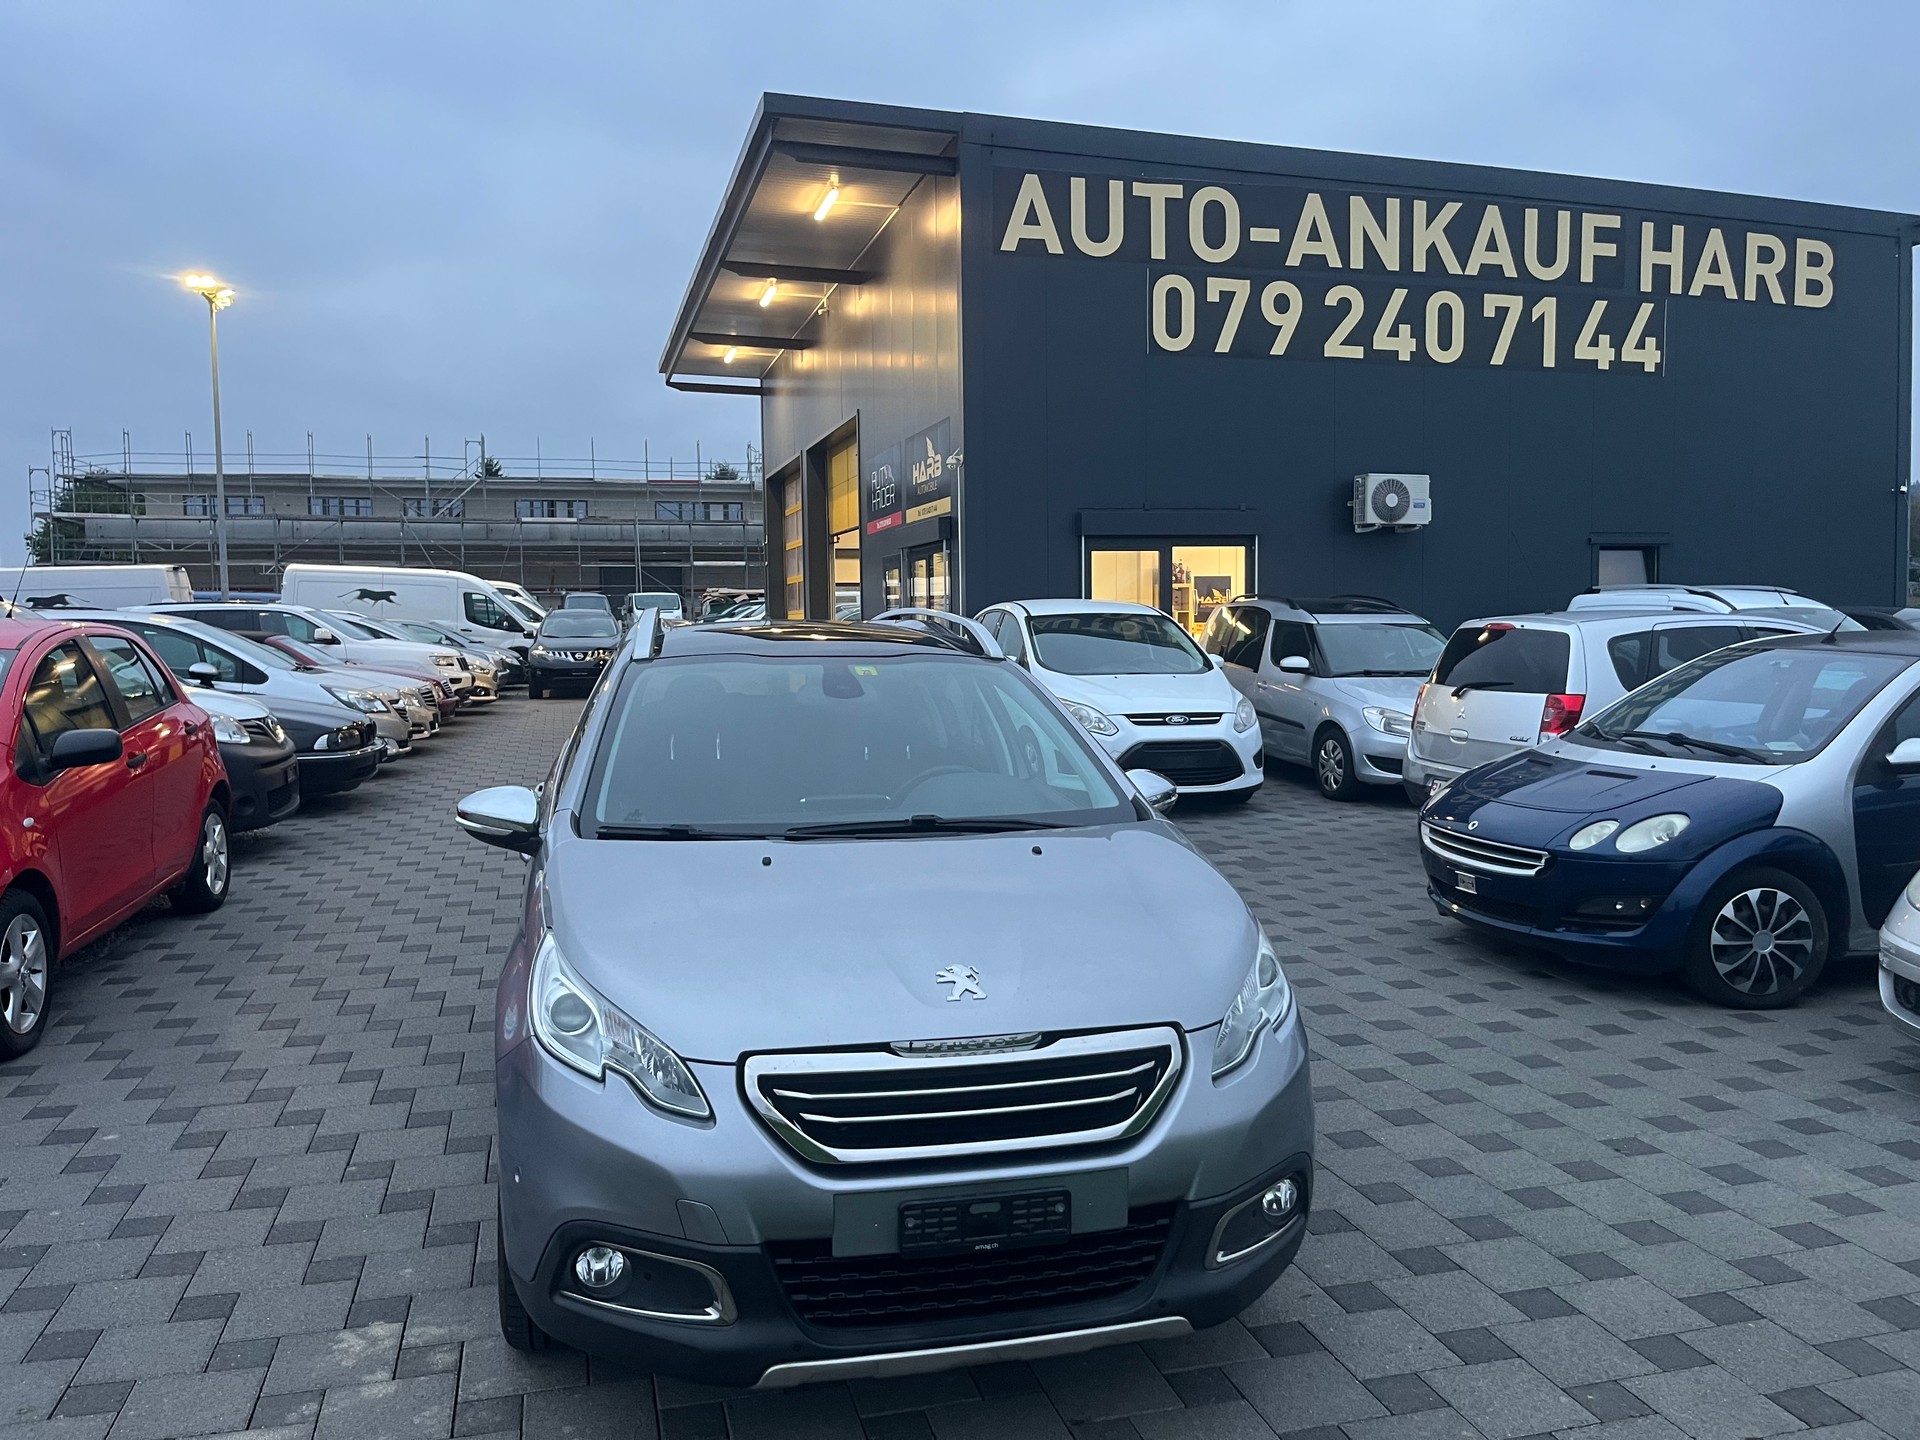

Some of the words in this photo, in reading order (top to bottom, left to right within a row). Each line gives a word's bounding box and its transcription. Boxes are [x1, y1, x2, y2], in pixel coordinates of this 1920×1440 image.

[1000, 173, 1621, 284] AUTO-ANKAUF
[1639, 221, 1835, 309] HARB
[1152, 273, 1304, 356] 079
[1323, 284, 1465, 364] 240
[1483, 292, 1557, 368] 71
[1573, 299, 1662, 373] 44
[912, 453, 942, 485] HARB
[925, 1036, 1018, 1052] PEUGEOT
